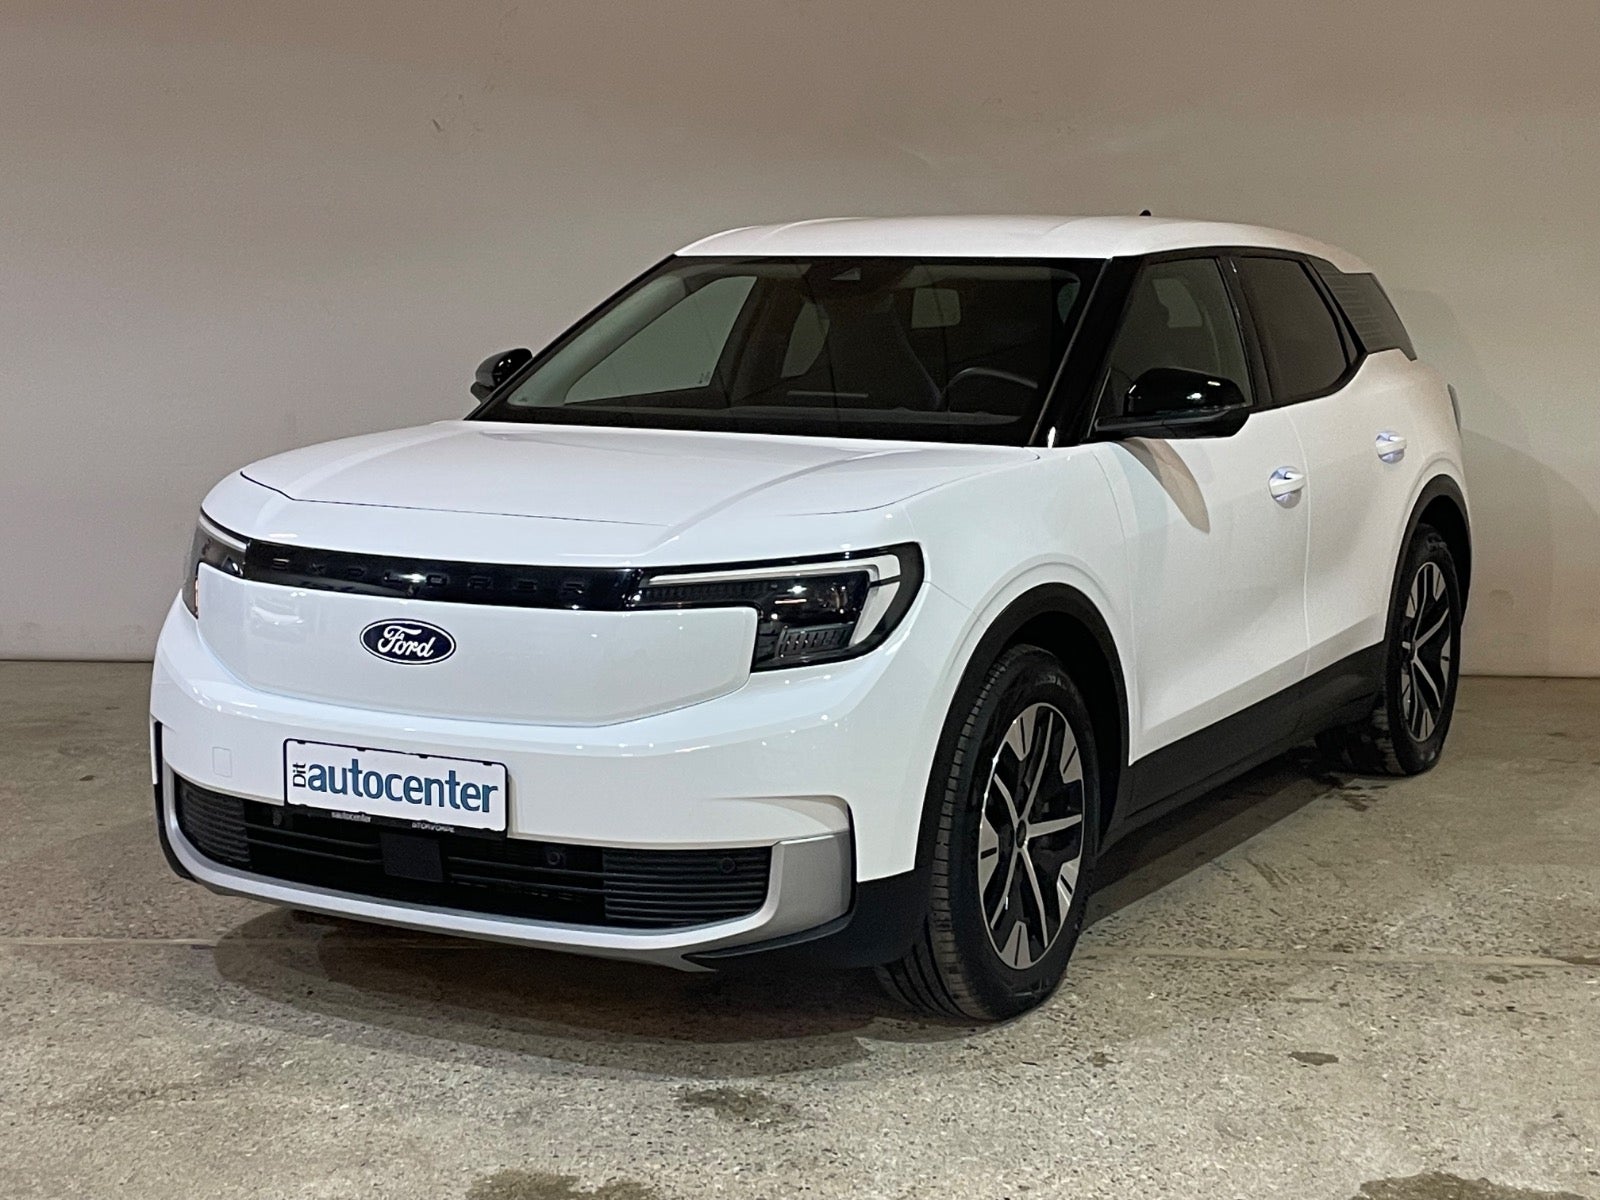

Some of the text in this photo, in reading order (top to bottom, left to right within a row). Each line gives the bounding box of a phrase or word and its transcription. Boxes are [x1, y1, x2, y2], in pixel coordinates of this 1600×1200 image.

[377, 625, 436, 658] Ford
[292, 758, 499, 813] Dit autocenter
